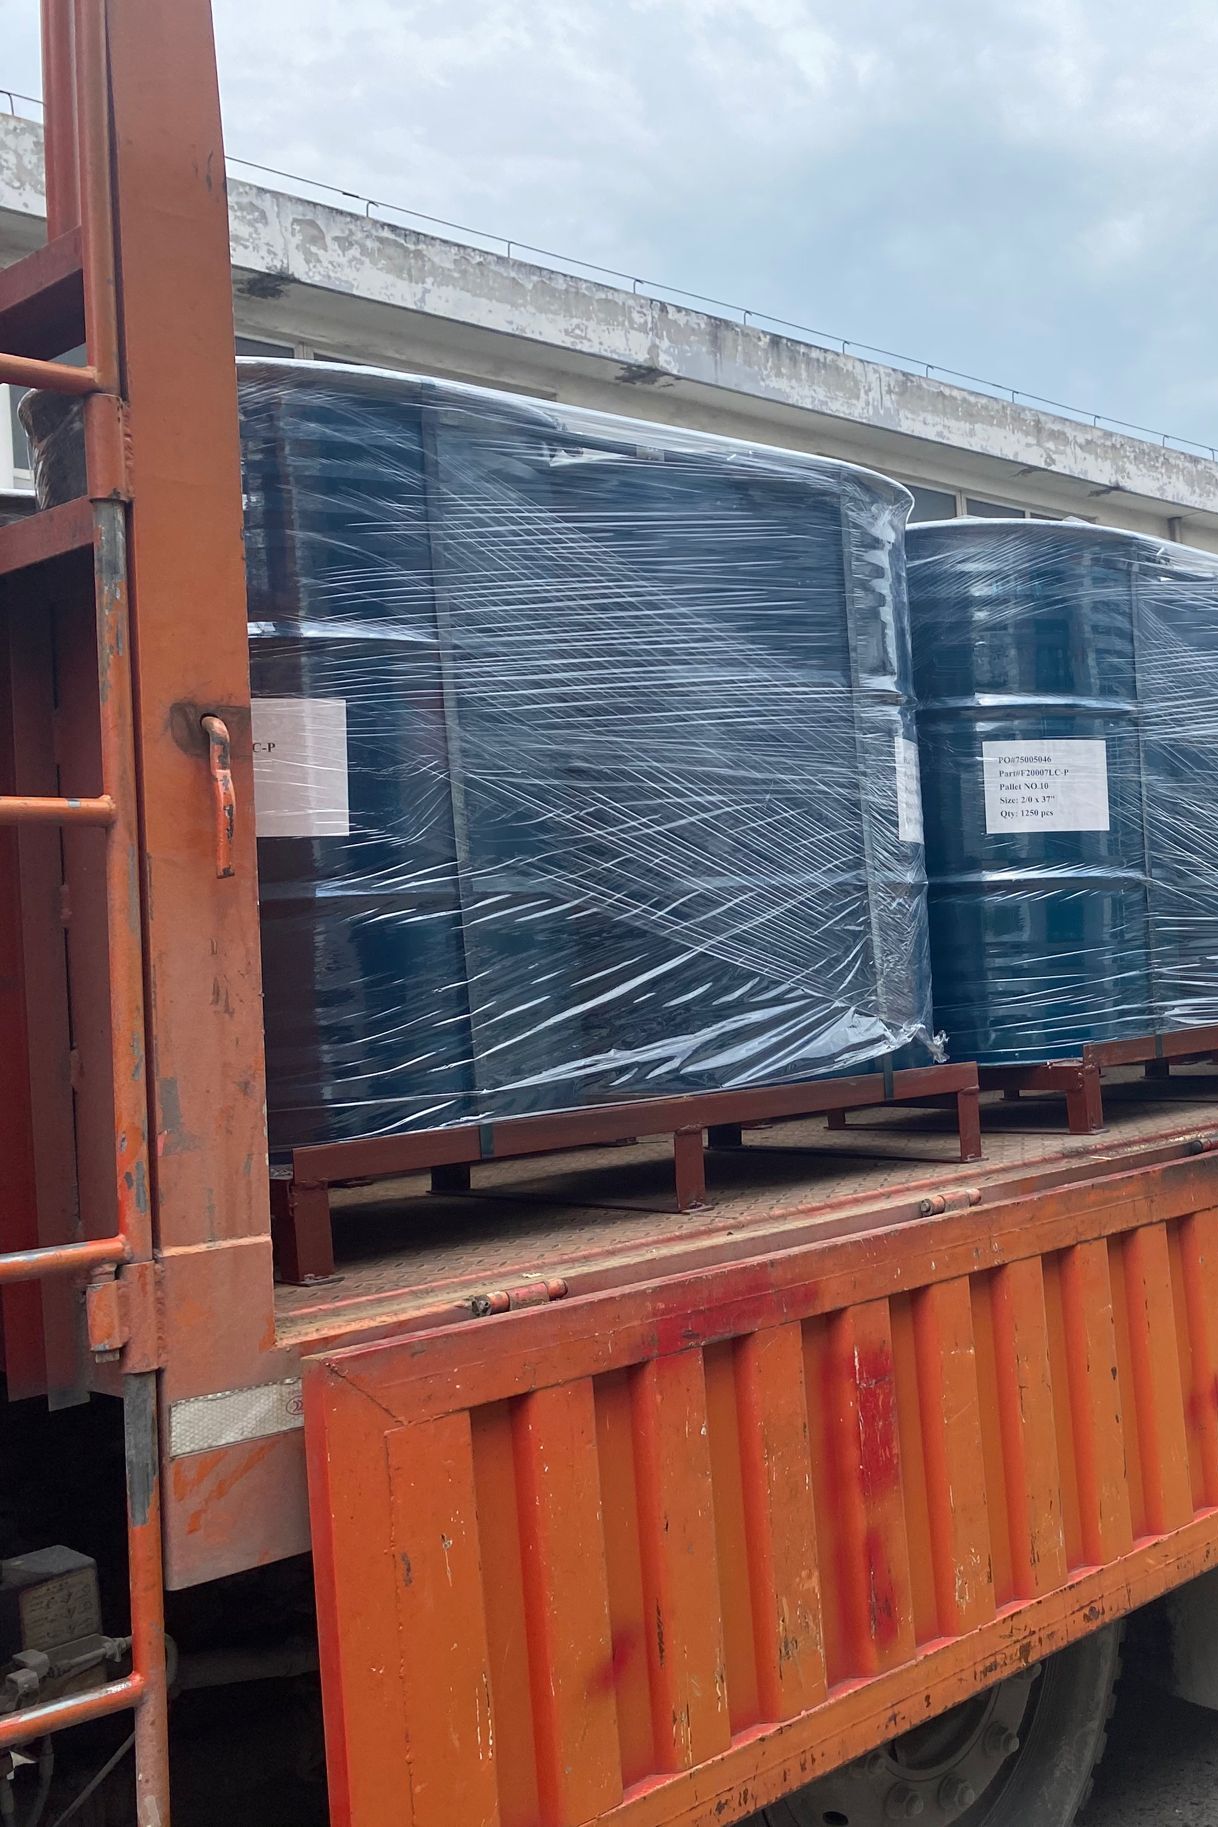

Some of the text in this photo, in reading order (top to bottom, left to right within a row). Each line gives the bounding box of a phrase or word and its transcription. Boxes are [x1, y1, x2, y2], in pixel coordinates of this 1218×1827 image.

[998, 756, 1052, 764] PO#75005046
[999, 769, 1069, 778] Part#F20007LC-P
[999, 782, 1049, 791] Pallet NO.10
[1021, 796, 1033, 804] 2/0
[1000, 810, 1018, 819] Qty:
